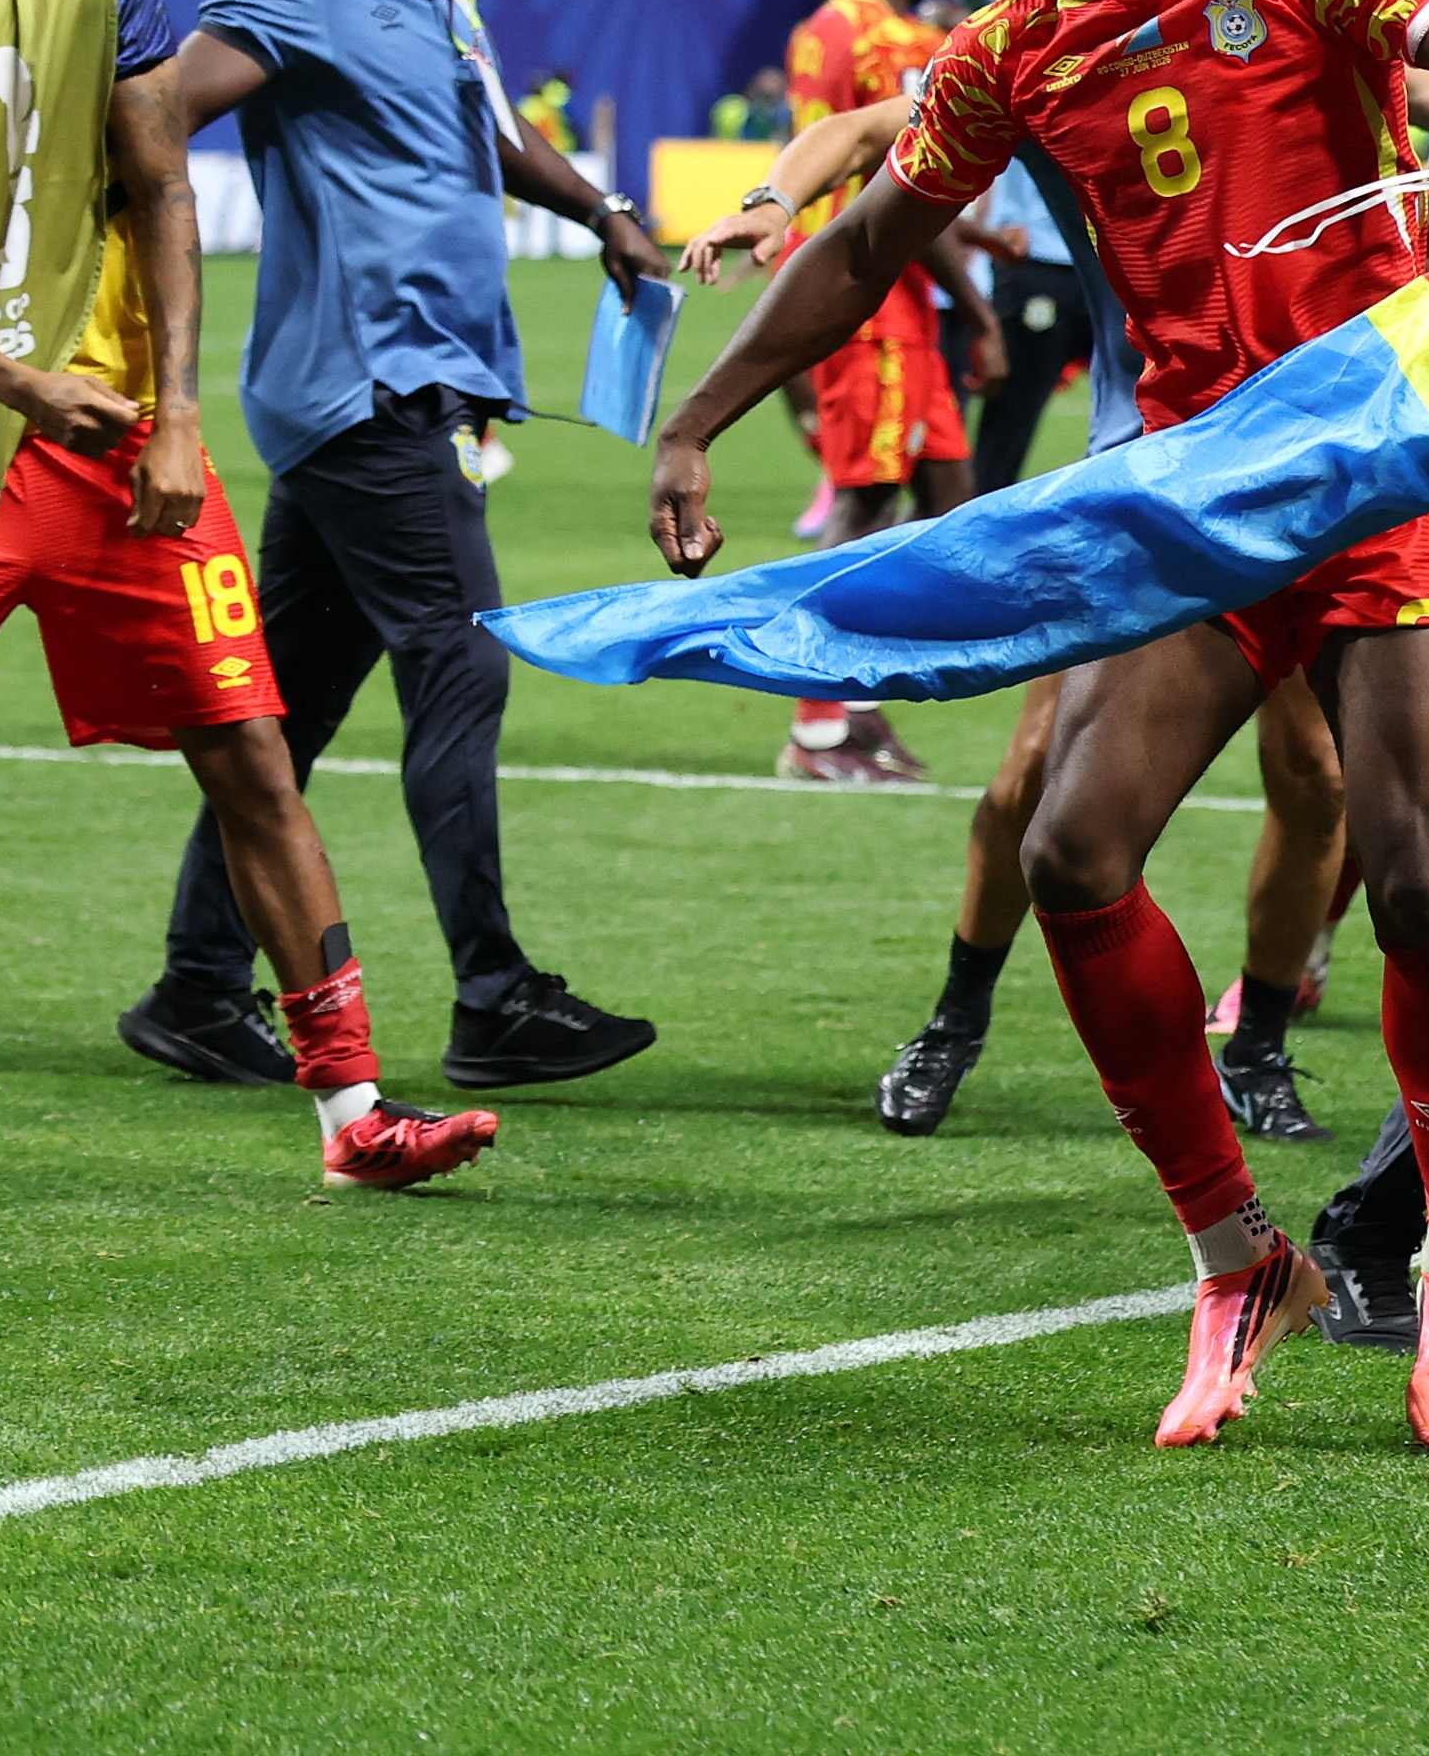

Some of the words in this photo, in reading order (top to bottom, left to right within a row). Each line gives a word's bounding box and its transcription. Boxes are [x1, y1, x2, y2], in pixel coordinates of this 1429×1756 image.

[1046, 73, 1082, 92] umbro
[1127, 86, 1201, 197] 8
[180, 553, 257, 644] 18
